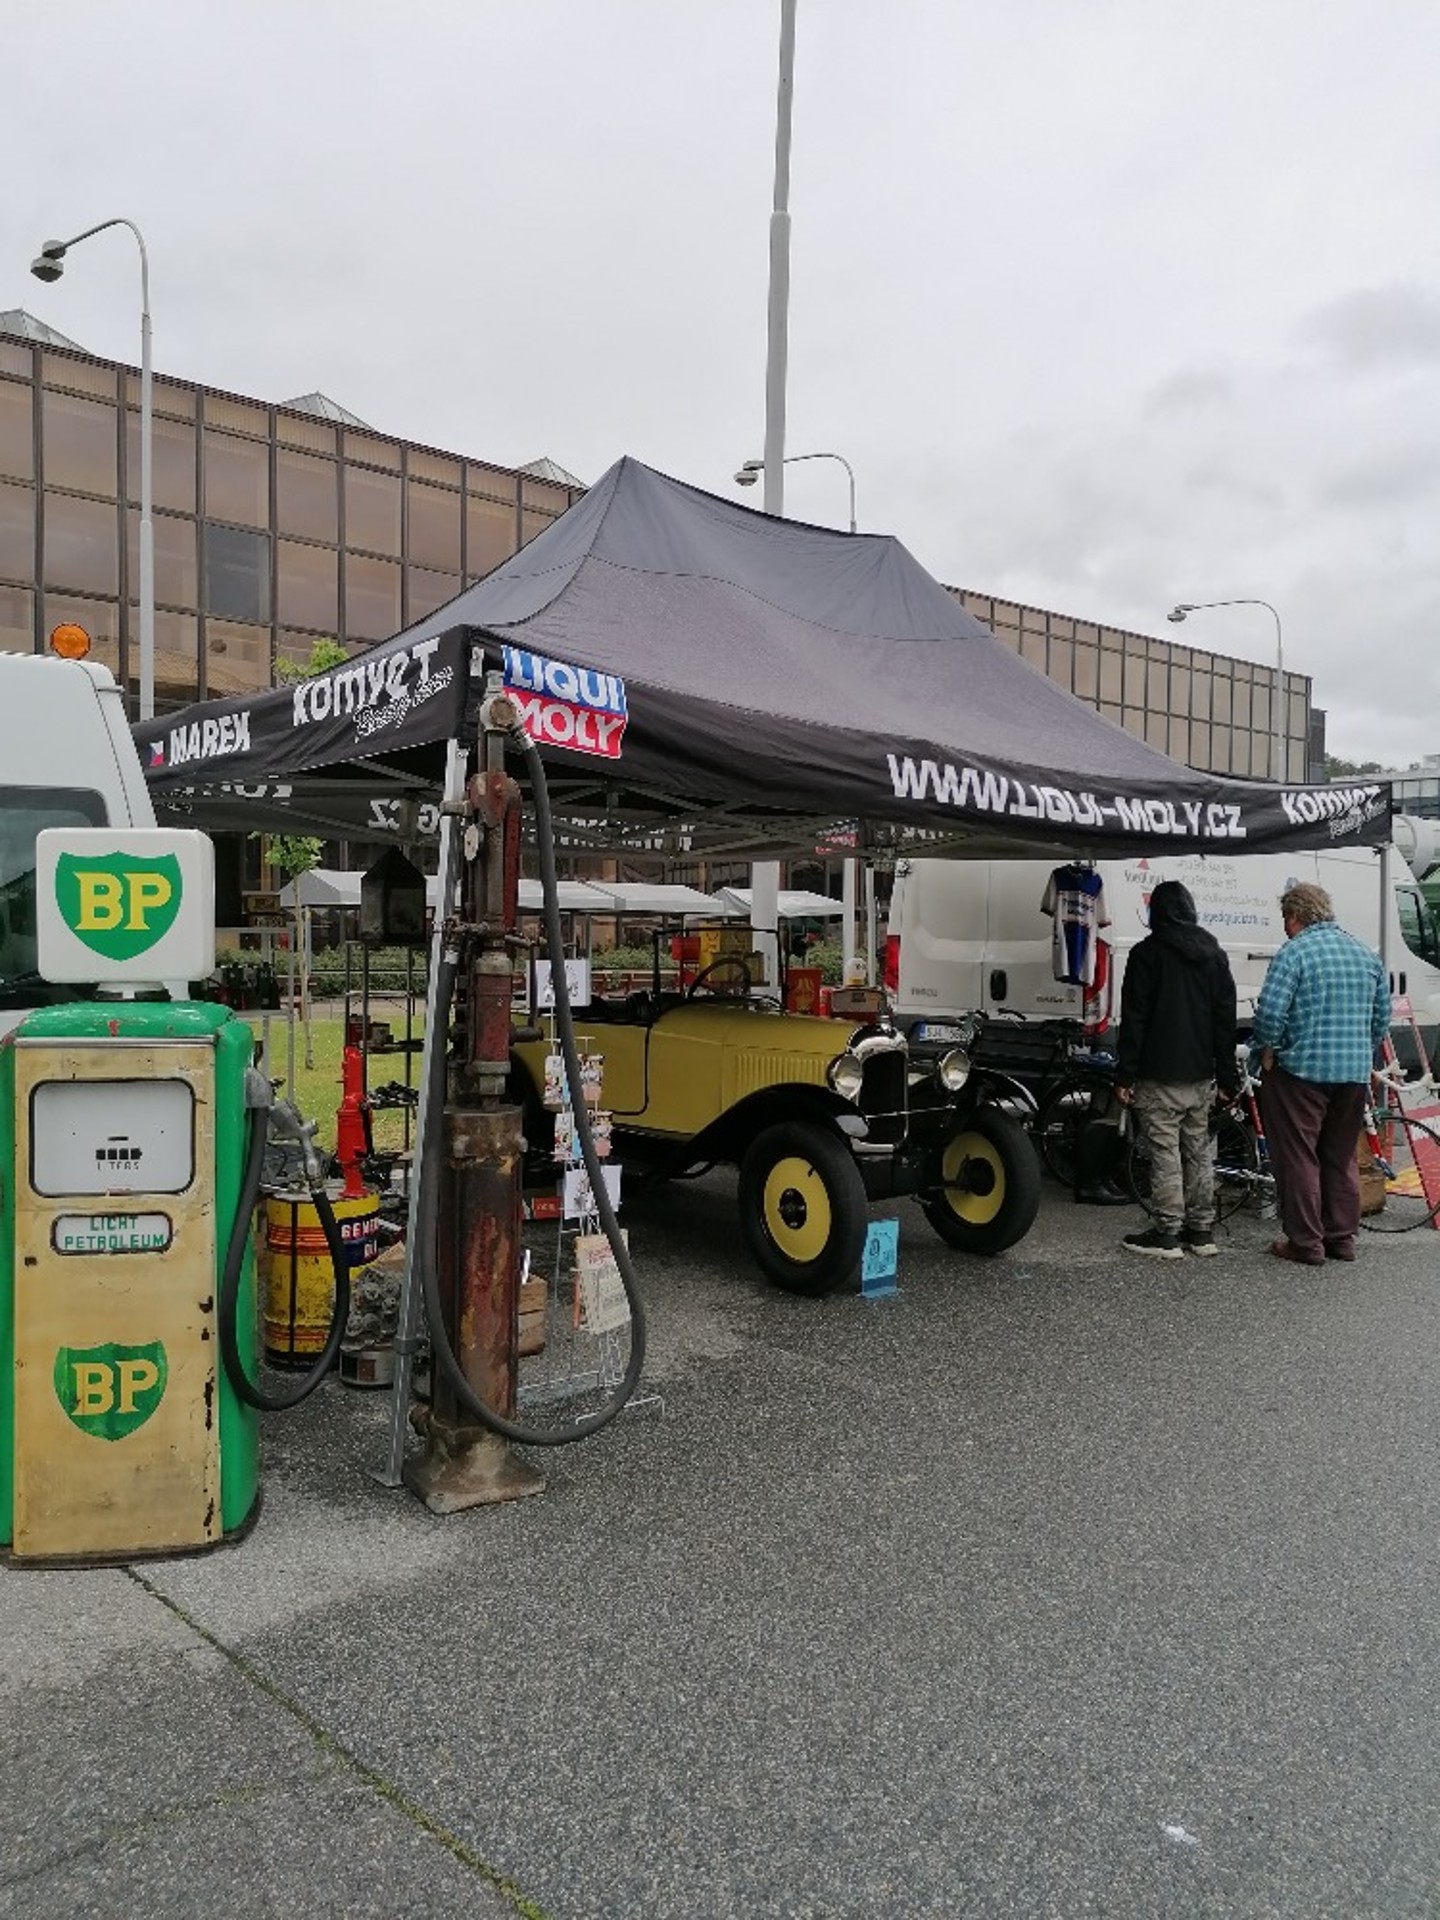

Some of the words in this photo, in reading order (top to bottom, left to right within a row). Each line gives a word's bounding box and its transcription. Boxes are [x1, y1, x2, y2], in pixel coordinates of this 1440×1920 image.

[510, 649, 620, 711] LIQUI
[168, 710, 250, 767] MAREK
[508, 692, 624, 752] MOLY
[887, 754, 1247, 838] WWW.LIQUI-MOLY.CZ
[73, 871, 172, 931] BP
[64, 1234, 164, 1250] PETROLEUM
[71, 1359, 159, 1417] BP
